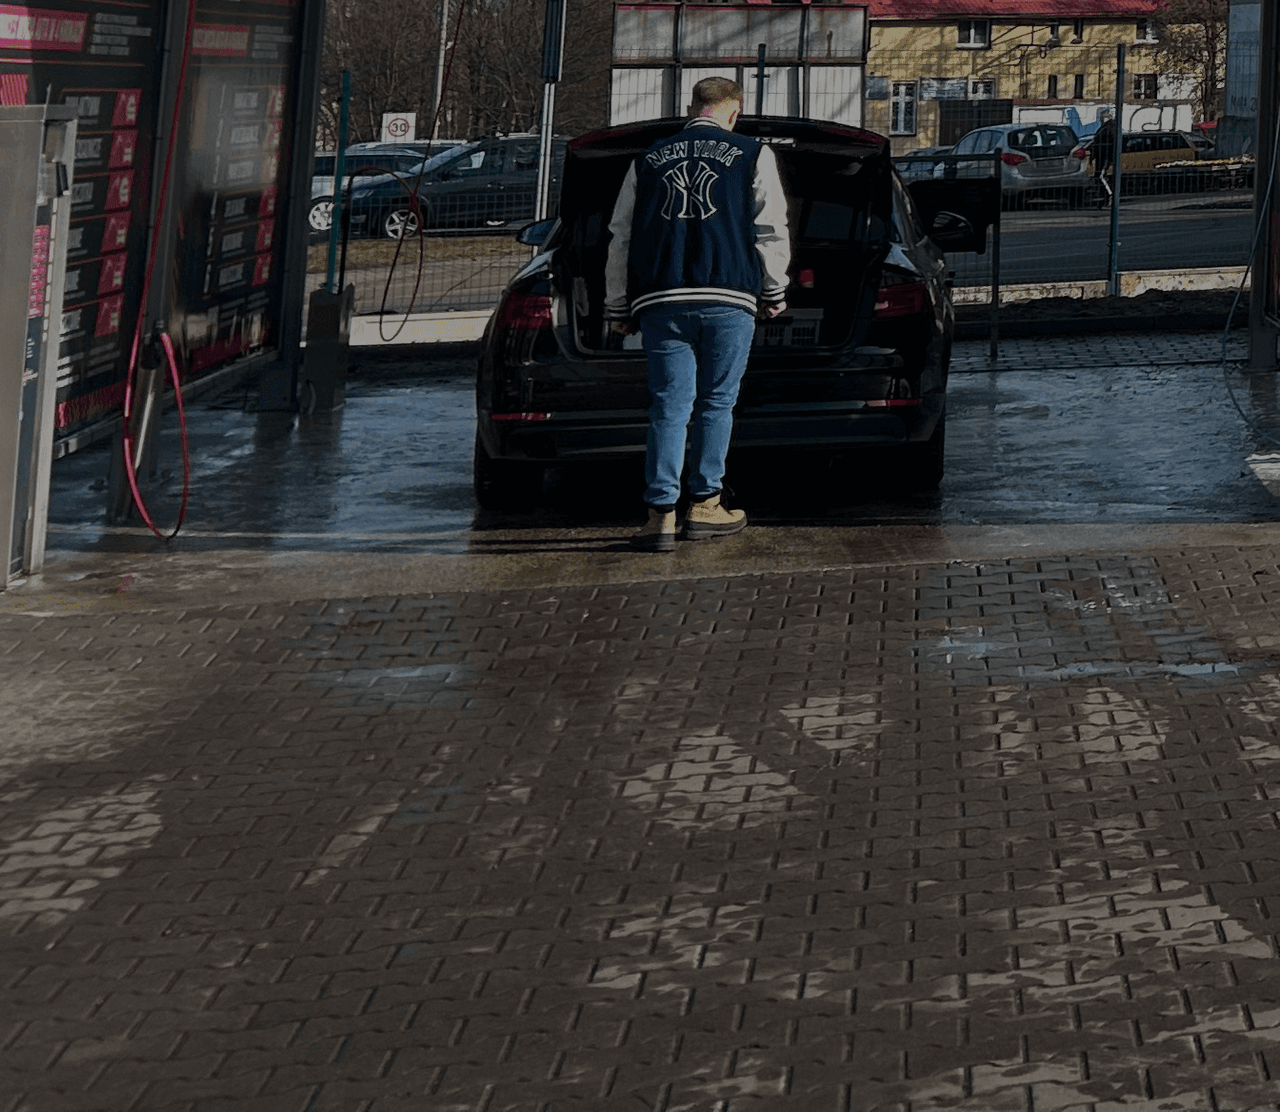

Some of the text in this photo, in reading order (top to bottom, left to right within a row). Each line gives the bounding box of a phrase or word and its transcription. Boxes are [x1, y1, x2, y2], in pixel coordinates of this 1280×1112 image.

[390, 122, 406, 133] 30
[645, 139, 744, 169] NEW YORK
